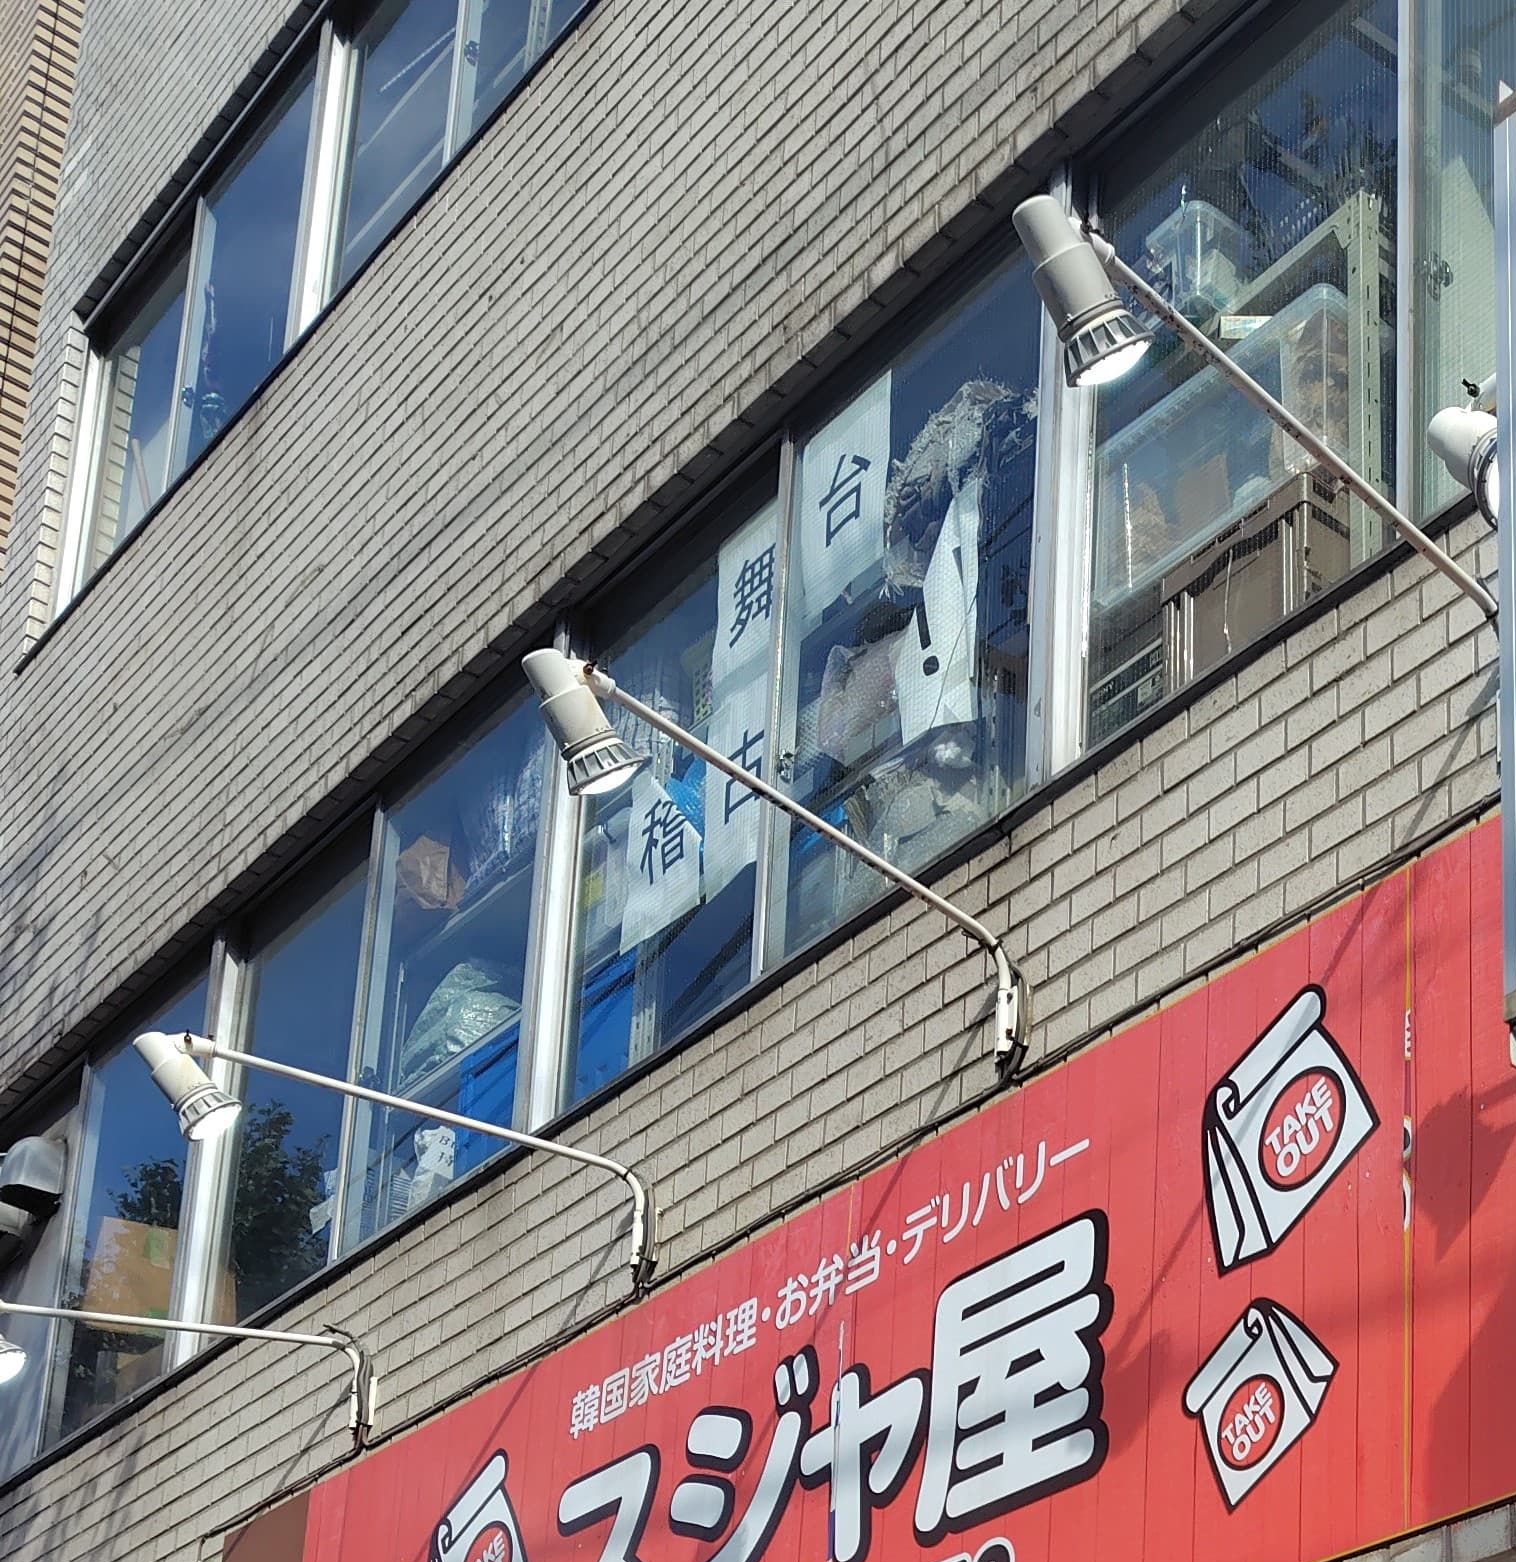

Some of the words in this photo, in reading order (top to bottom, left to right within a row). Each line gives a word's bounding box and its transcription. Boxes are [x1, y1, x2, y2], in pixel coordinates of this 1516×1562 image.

[1265, 1077, 1331, 1150] TAKE
[1278, 1096, 1336, 1178] OUT
[1221, 1381, 1272, 1444] TAKE
[1232, 1400, 1276, 1463] OUT
